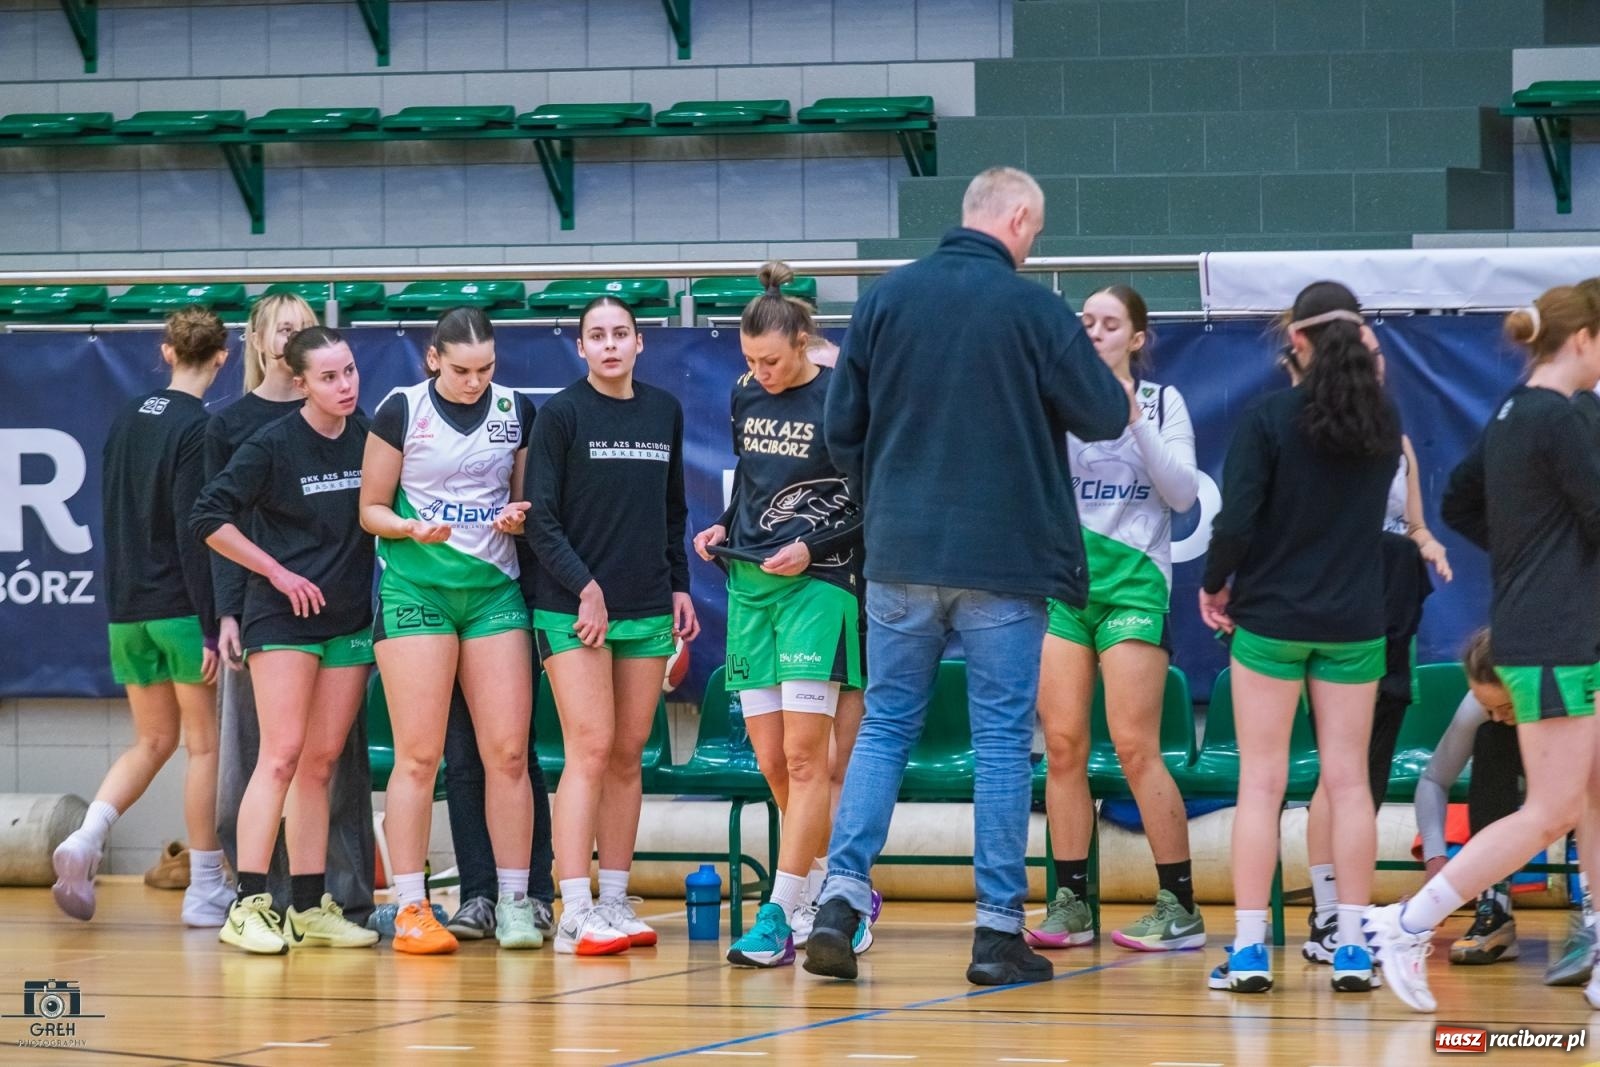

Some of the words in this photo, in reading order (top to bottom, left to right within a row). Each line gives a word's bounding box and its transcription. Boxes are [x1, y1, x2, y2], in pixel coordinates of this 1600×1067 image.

[138, 397, 170, 415] 26
[487, 420, 520, 443] 25
[744, 417, 778, 436] RKK
[778, 421, 815, 440] AZS
[744, 436, 810, 458] RACIBÓRZ
[300, 475, 320, 484] RKK
[322, 472, 339, 481] AZS
[343, 470, 363, 478] RACI
[1081, 480, 1150, 500] Clavis
[0, 559, 95, 604] ÓRZ
[727, 654, 749, 680] 14
